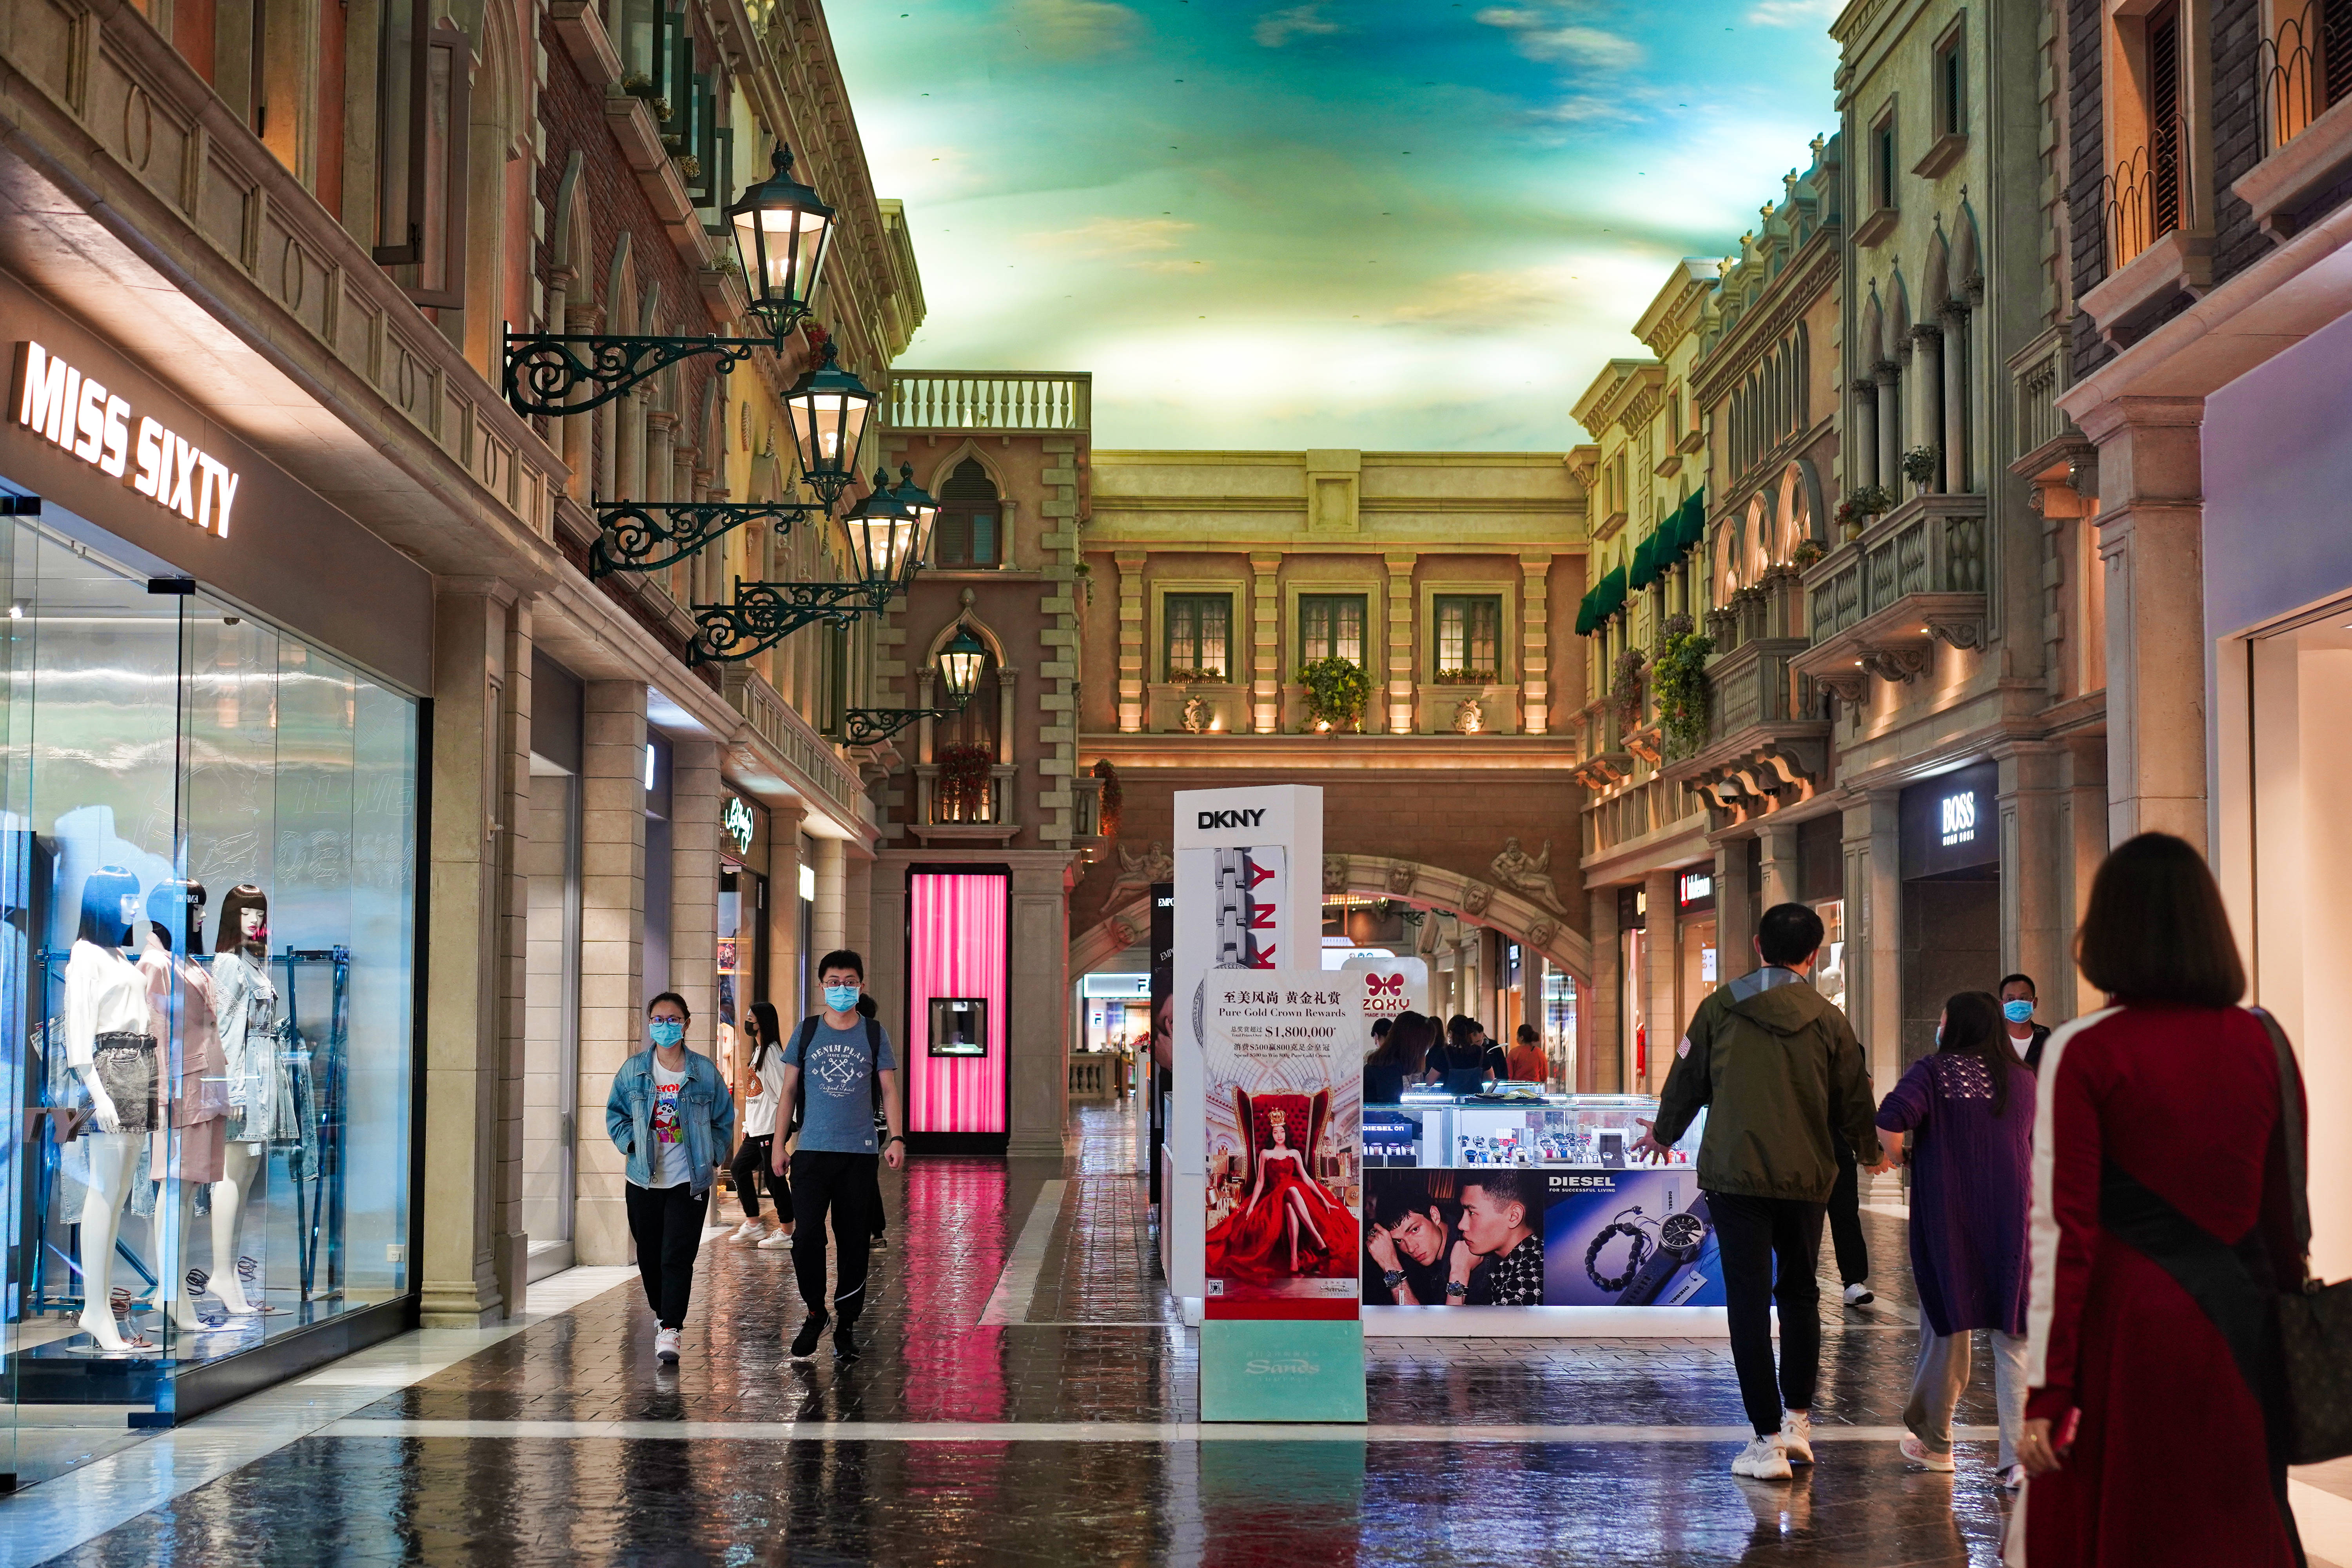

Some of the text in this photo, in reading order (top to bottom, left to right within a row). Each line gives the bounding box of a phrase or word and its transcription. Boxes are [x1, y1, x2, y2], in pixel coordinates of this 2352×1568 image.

[20, 340, 239, 539] MISS SIXTY
[1198, 809, 1266, 829] DKNY
[1942, 791, 1975, 833] BOSS
[1223, 991, 1341, 1005] 至美风尚 黄金礼赏
[1219, 1008, 1346, 1017] Pure Gold Crown Rewards
[811, 1044, 841, 1060] DENIM
[819, 1083, 855, 1092] Original Spirit
[1549, 1176, 1615, 1186] DIESEL
[1669, 1286, 1690, 1303] DIESEL
[1243, 1359, 1320, 1374] Sands
